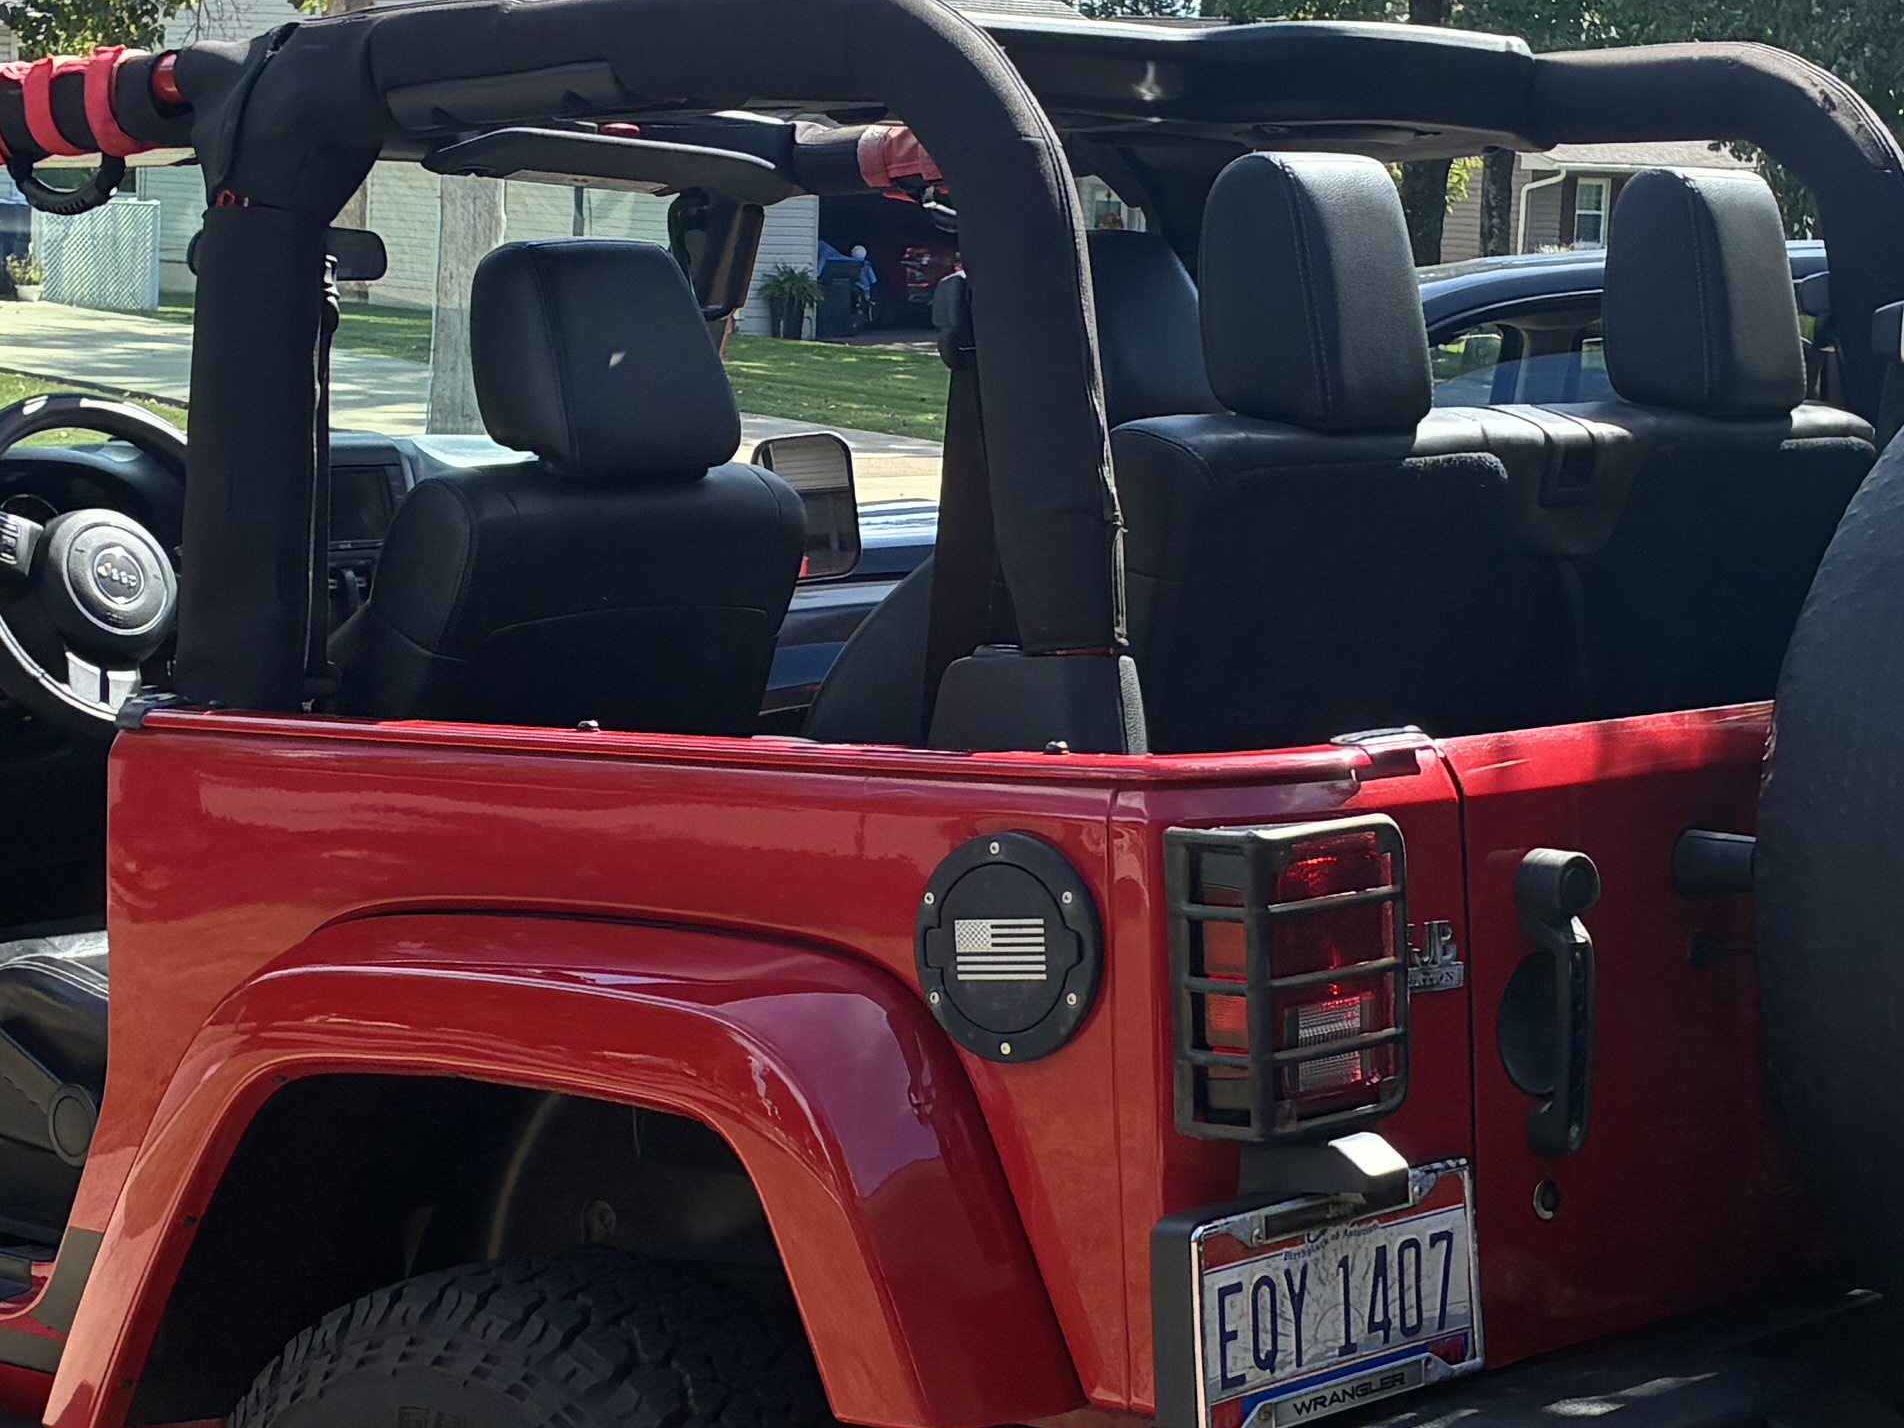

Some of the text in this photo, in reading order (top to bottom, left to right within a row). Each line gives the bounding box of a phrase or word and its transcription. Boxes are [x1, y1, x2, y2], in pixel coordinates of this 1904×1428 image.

[1217, 1230, 1455, 1391] EQY 1407
[1293, 1372, 1406, 1416] WRANGLER
